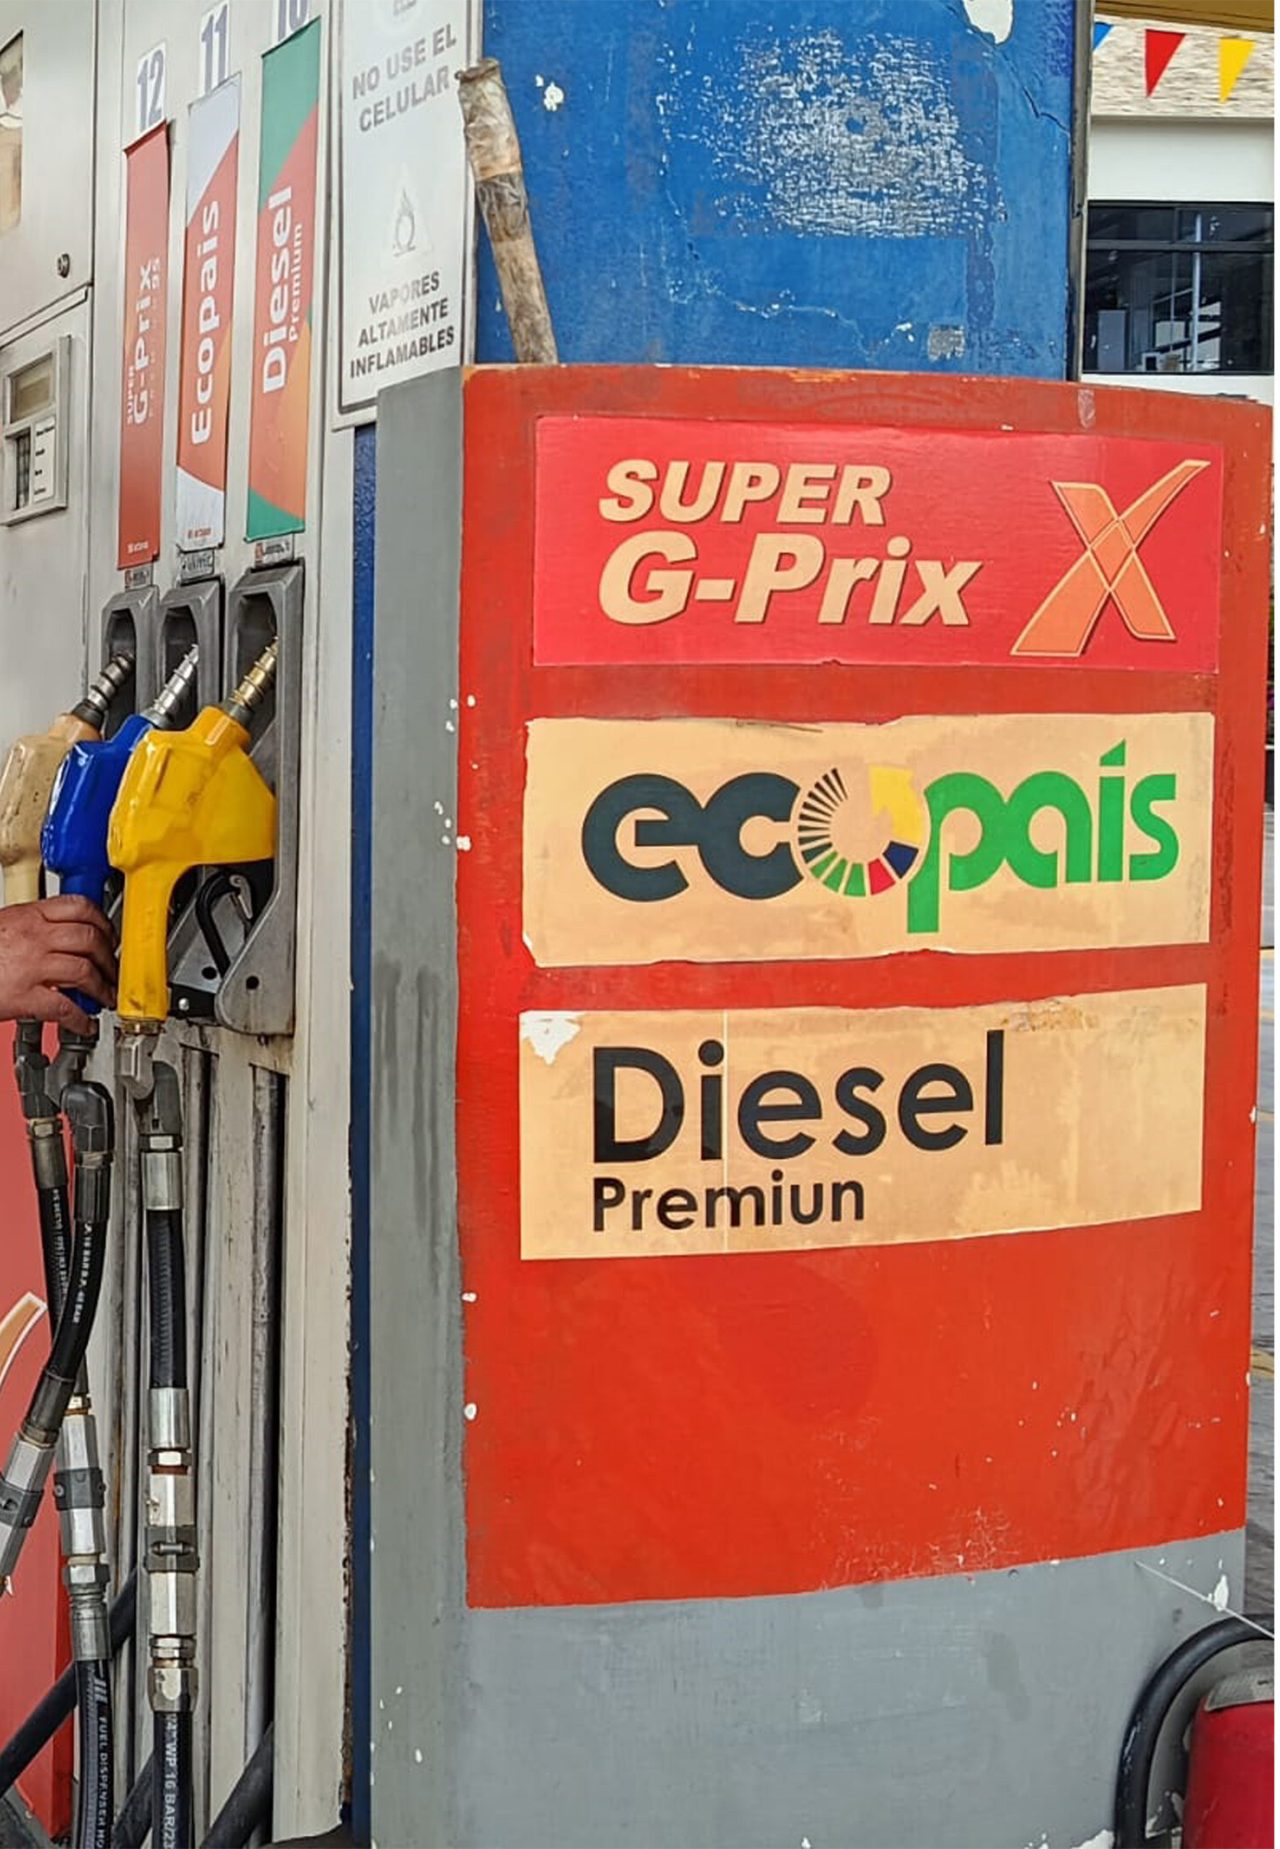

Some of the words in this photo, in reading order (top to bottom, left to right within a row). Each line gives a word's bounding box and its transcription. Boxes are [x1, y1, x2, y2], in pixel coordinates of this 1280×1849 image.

[201, 4, 228, 95] 11
[352, 66, 380, 100] NO
[387, 38, 426, 79] USE
[433, 23, 457, 56] EL
[137, 49, 164, 132] 12
[359, 65, 450, 132] CELULAR
[263, 186, 292, 393] Diesel
[289, 224, 302, 342] Premium
[369, 271, 440, 315] VAPORES
[133, 259, 152, 424] G-Prix
[192, 200, 219, 444] Ecopais
[350, 325, 455, 378] INFLAMABLES
[358, 297, 449, 348] ALTAMENTE
[599, 458, 892, 526] SUPER
[599, 531, 984, 626] G-Prix
[593, 1030, 1004, 1163] Diesel
[593, 1170, 865, 1232] Premiun
[81, 1249, 91, 1270] BAR
[72, 1303, 84, 1324] BAR
[98, 1716, 108, 1749] FUEL
[165, 1742, 178, 1766] WP
